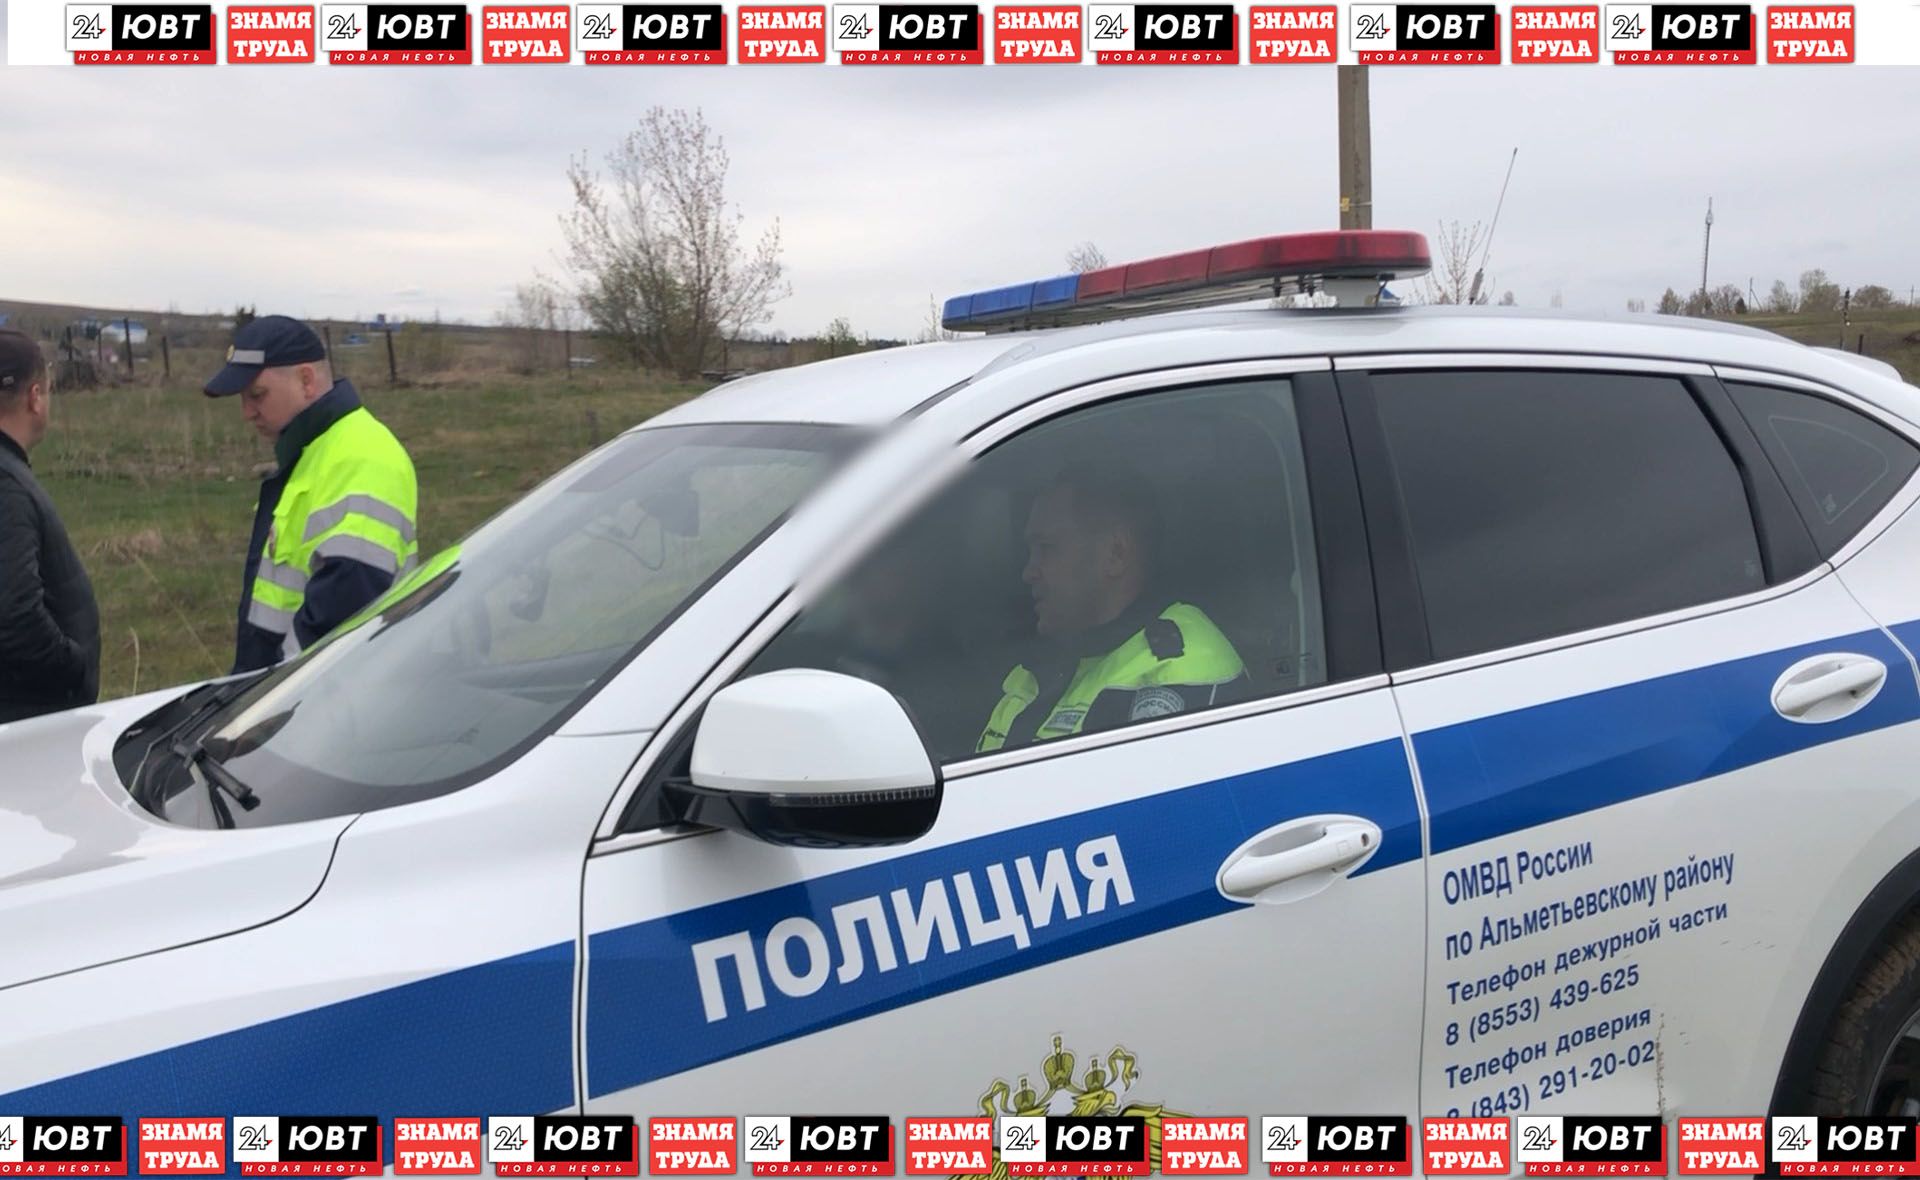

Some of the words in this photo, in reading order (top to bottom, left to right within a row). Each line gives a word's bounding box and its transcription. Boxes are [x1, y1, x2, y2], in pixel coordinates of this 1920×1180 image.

[1443, 856, 1512, 905] ОМВД
[1517, 842, 1593, 884] России
[1446, 929, 1472, 960] по
[1480, 874, 1657, 950] Альметьевскому
[1664, 853, 1734, 901] району
[691, 834, 1135, 1023] ПОЛИЦИЯ
[1447, 959, 1545, 1005] Телефон
[1554, 920, 1661, 975] дежурной
[1669, 902, 1728, 933] части
[1445, 1022, 1459, 1046] 8
[1470, 996, 1540, 1043] (8553)
[1549, 964, 1640, 1009] 439-625
[1445, 1041, 1546, 1089] Телефон
[1555, 1008, 1651, 1057] доверия
[1471, 1083, 1530, 1118] (843)
[1538, 1040, 1656, 1099] 291-20-02
